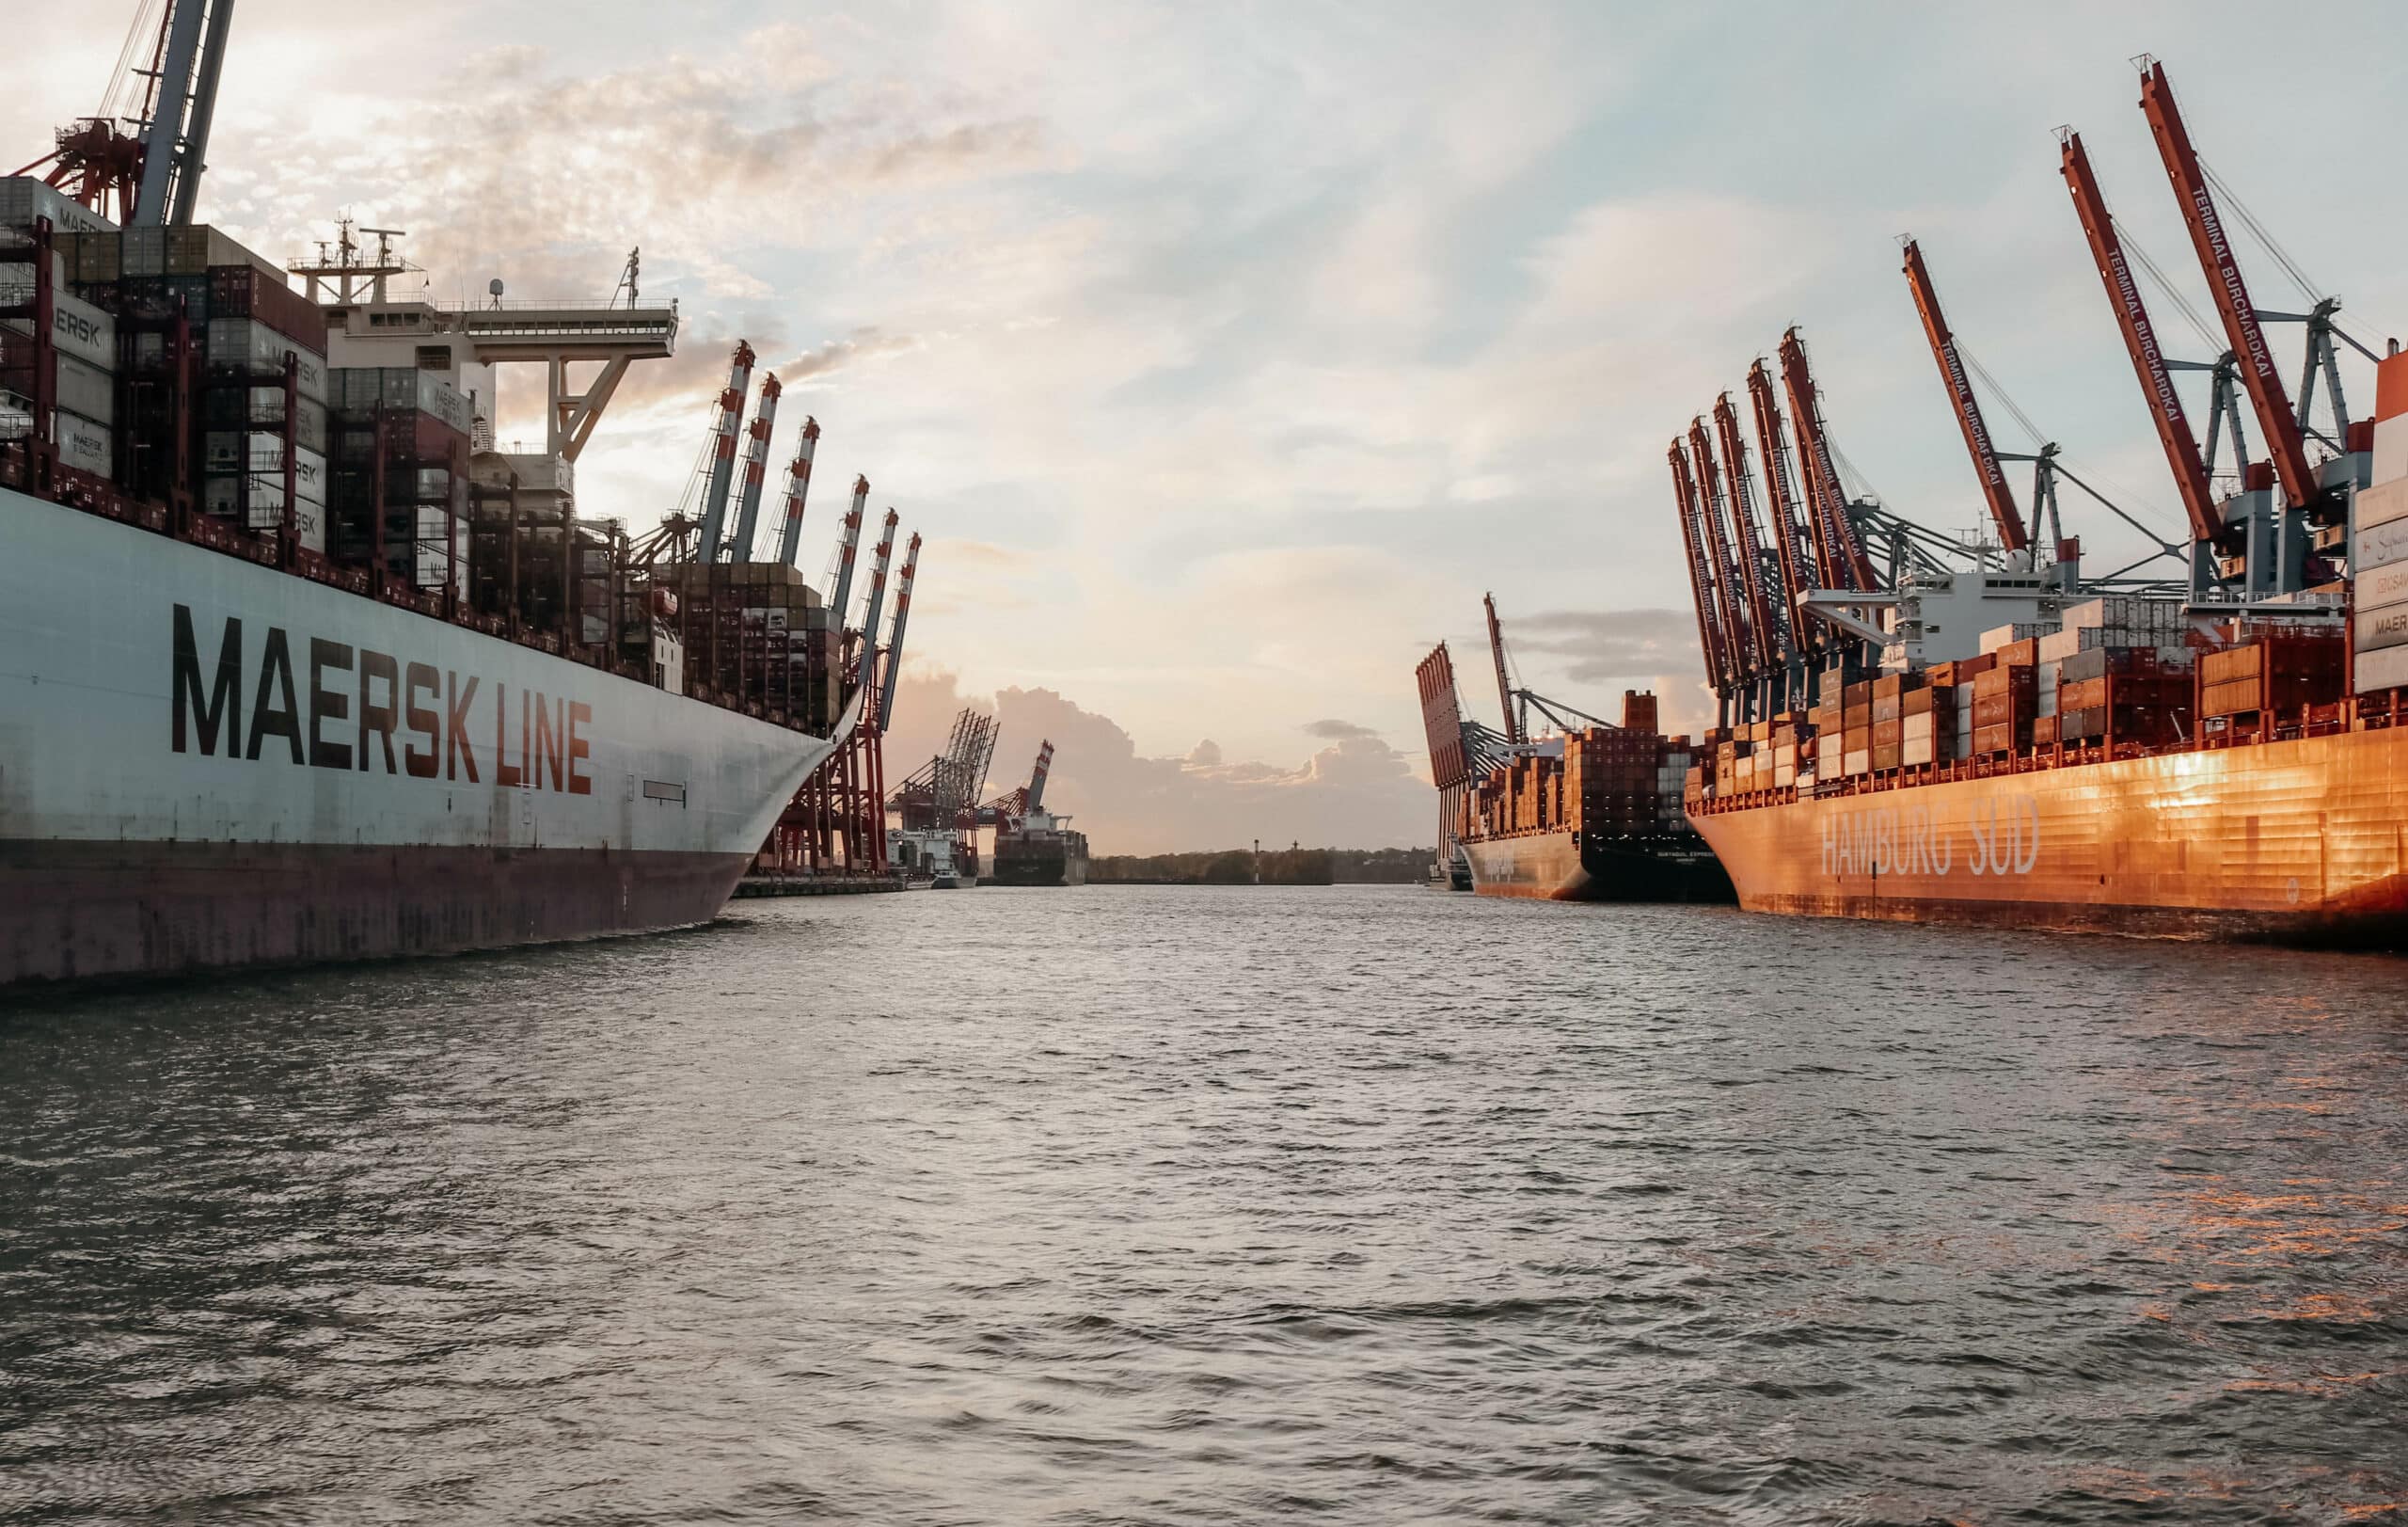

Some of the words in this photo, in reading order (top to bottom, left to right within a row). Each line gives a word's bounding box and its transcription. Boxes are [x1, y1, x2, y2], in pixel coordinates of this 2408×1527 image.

[53, 307, 101, 348] ERSK
[2193, 185, 2228, 264] TERMINAL
[2221, 266, 2272, 377] BURCHARDKAI
[1941, 341, 1968, 399] TERMINAL
[2108, 248, 2140, 319] TERMINAL
[2134, 321, 2180, 422] BURCHARDKAI
[1814, 439, 1836, 485] TERMINAL
[1737, 474, 1751, 523] TERMINAL
[1746, 526, 1765, 596] BURCHARDKAI
[1772, 448, 1788, 498] TERMINAL
[1782, 501, 1803, 577] BURCHARDKAI
[1697, 559, 1715, 623] BURCHARDKAI
[1719, 544, 1737, 611] BURCHARDKAI
[172, 603, 480, 784] MAERSK
[497, 682, 592, 796] LINE
[1822, 802, 1952, 876] HAMBURG
[1969, 783, 2040, 876] SÜD
